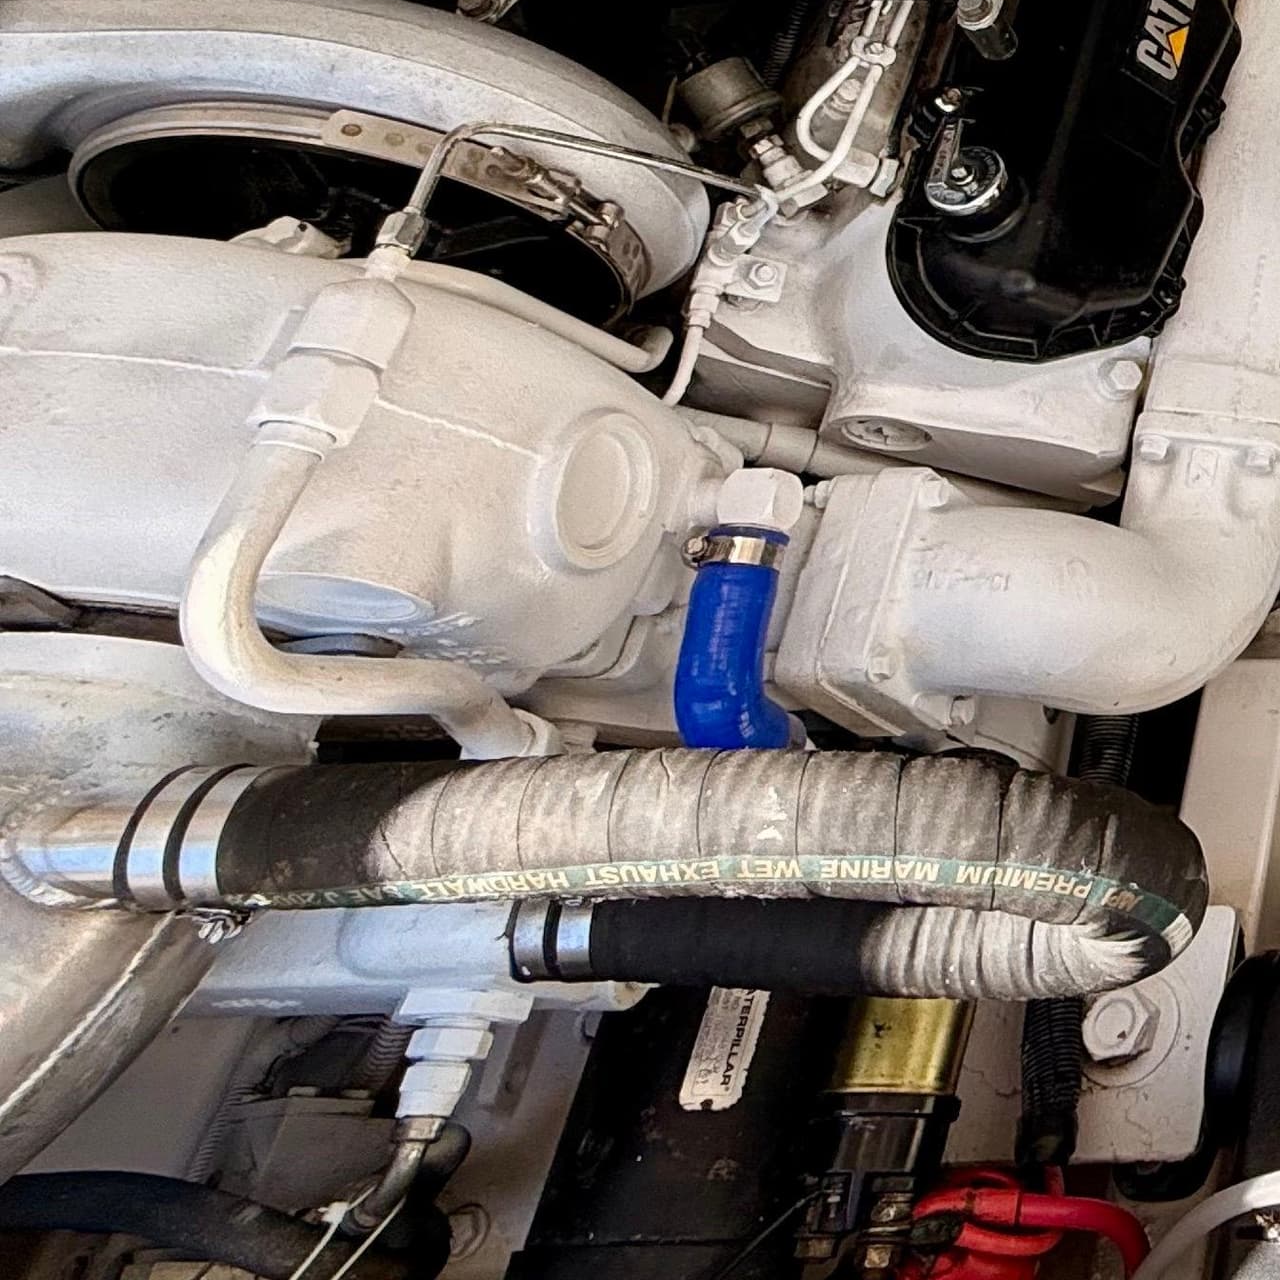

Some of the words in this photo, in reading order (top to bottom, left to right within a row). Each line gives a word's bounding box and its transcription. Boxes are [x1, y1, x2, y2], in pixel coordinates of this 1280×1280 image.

[585, 859, 720, 888] EXHAUST
[736, 859, 801, 880] WET
[819, 858, 940, 882] MARINE
[956, 863, 1092, 898] PREMIUM
[411, 870, 569, 898] HARDWALL
[719, 988, 757, 1087] TERPILLAR
